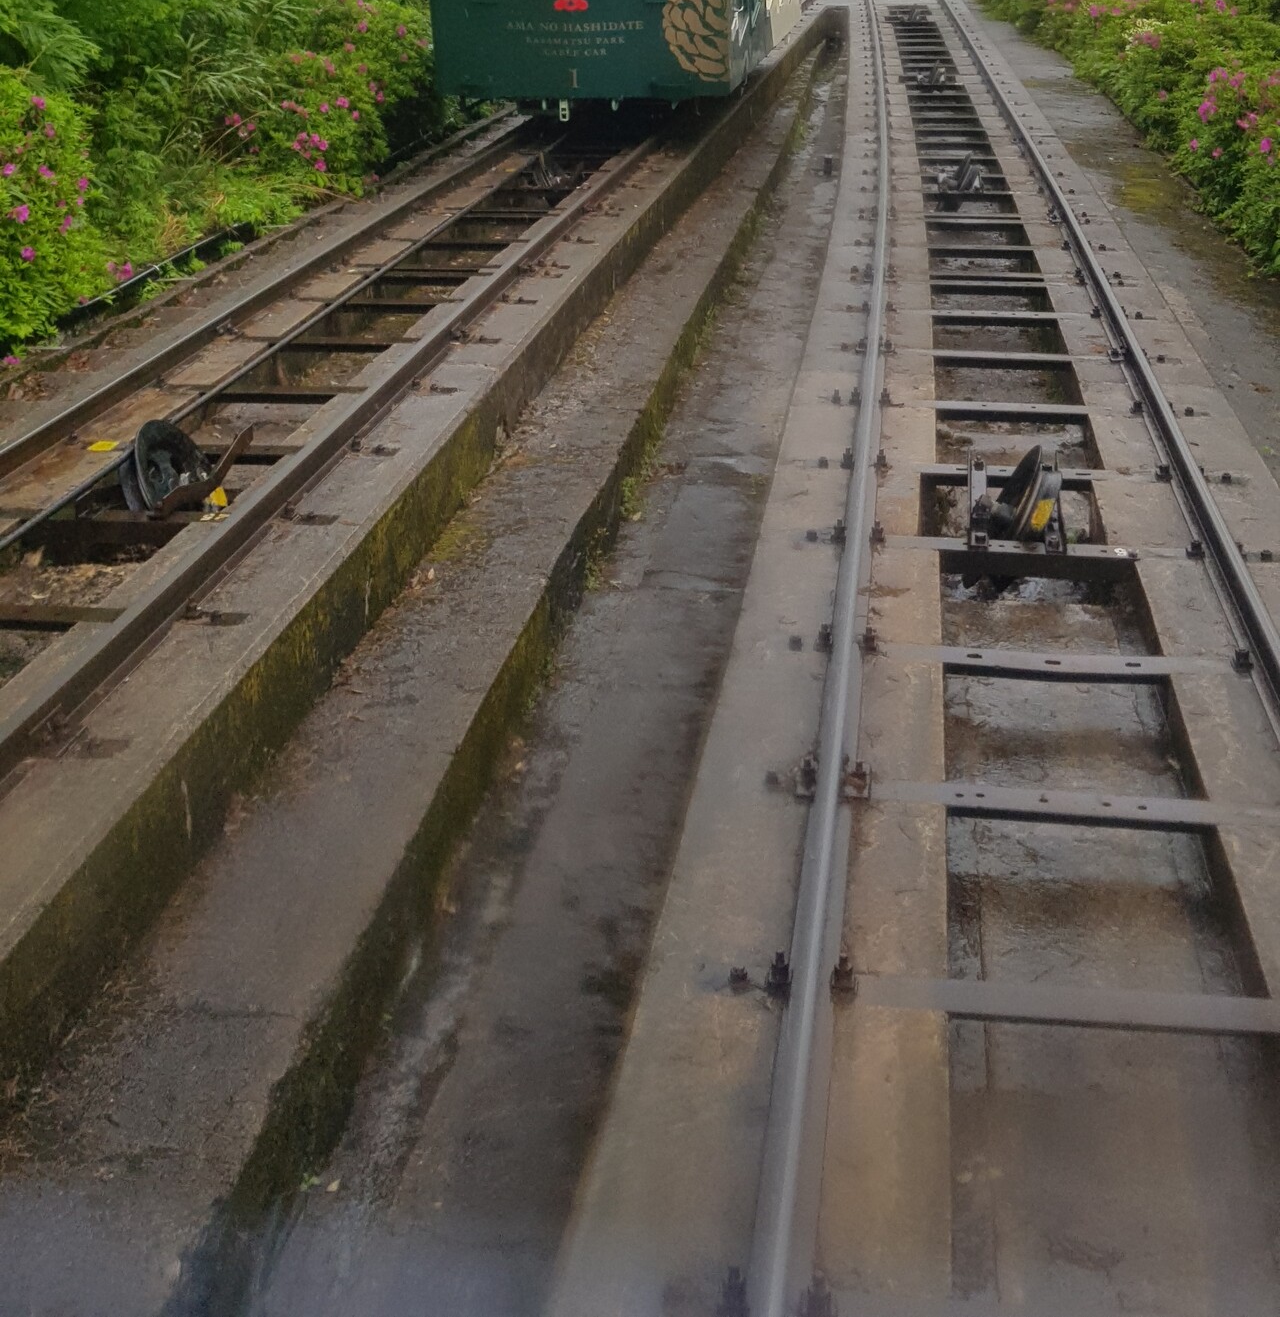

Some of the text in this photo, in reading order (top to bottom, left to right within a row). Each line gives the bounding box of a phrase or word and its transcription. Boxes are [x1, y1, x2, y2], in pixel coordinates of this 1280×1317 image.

[506, 20, 644, 32] AMA NO HASHIDATE
[596, 36, 625, 45] PARK
[584, 48, 607, 57] CAR
[568, 68, 579, 89] 1
